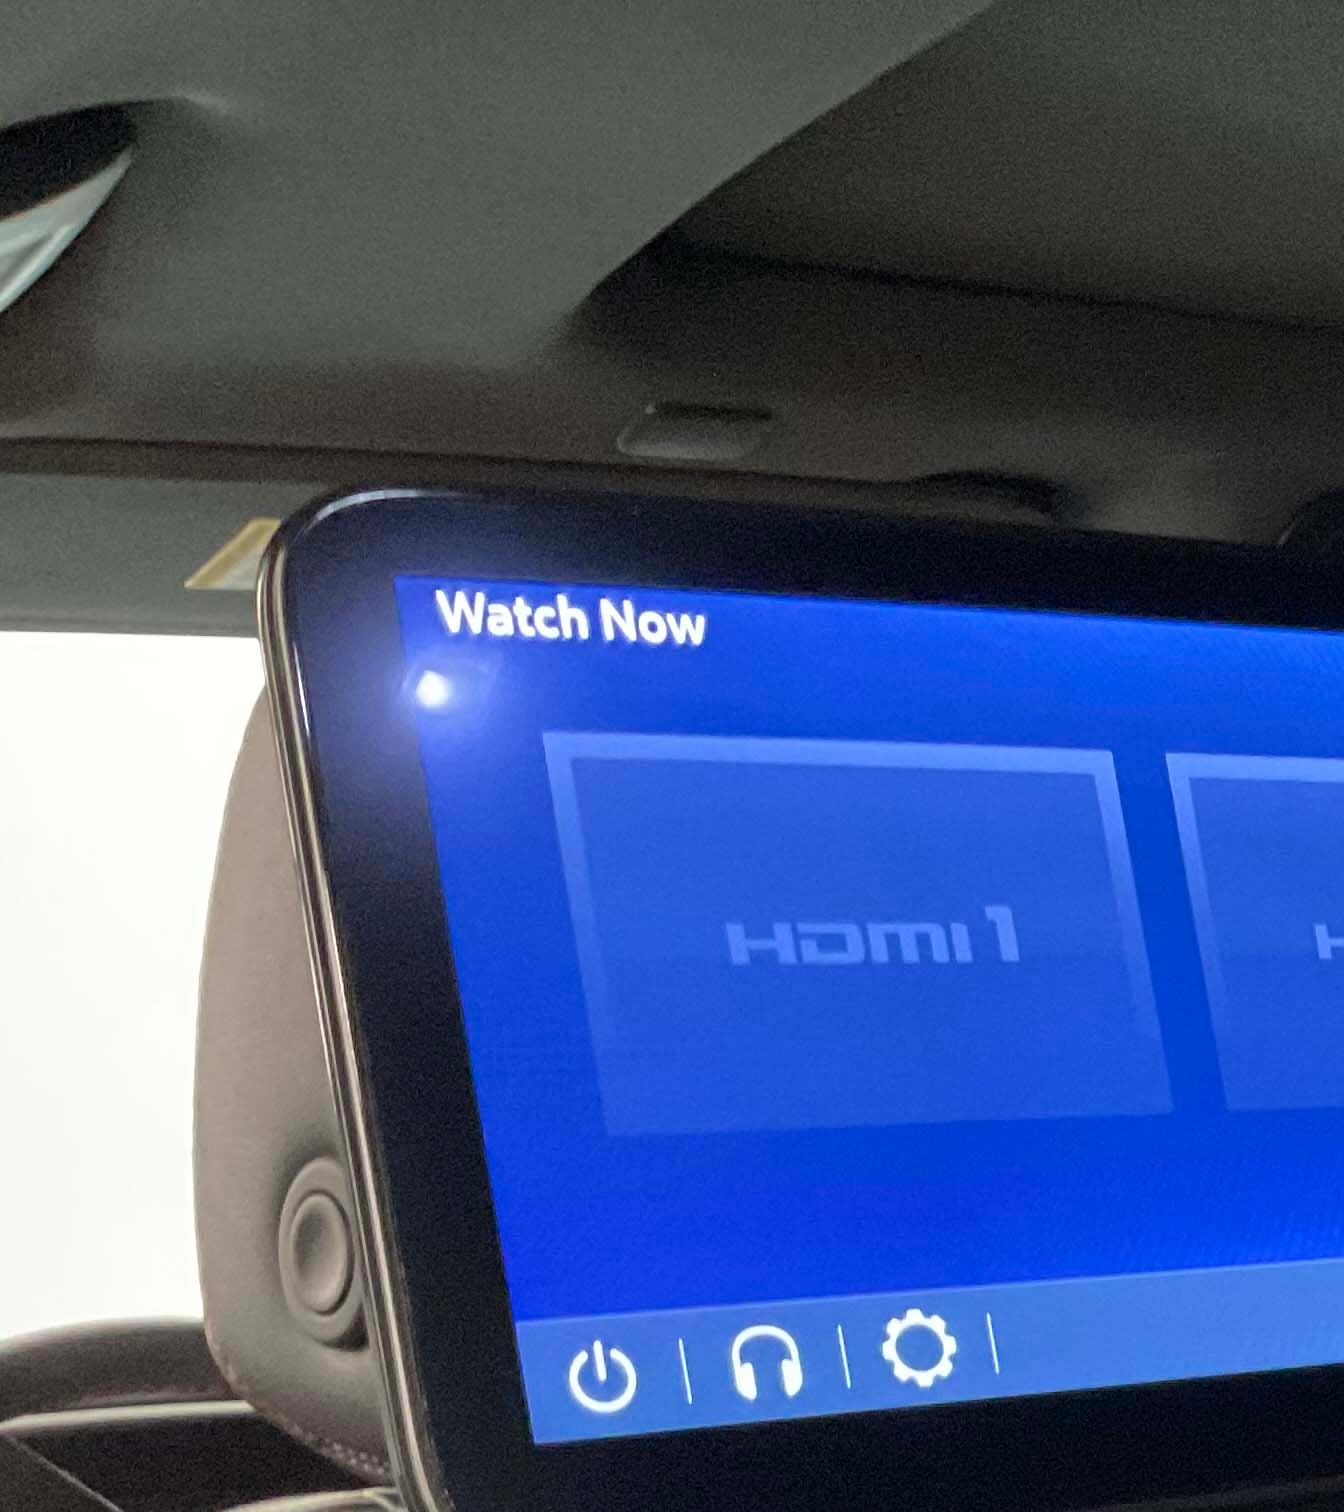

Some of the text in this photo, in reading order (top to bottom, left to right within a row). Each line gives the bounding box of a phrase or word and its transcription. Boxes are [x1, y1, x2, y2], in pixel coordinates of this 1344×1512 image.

[435, 589, 706, 646] Watch Now
[726, 921, 973, 966] HDMI
